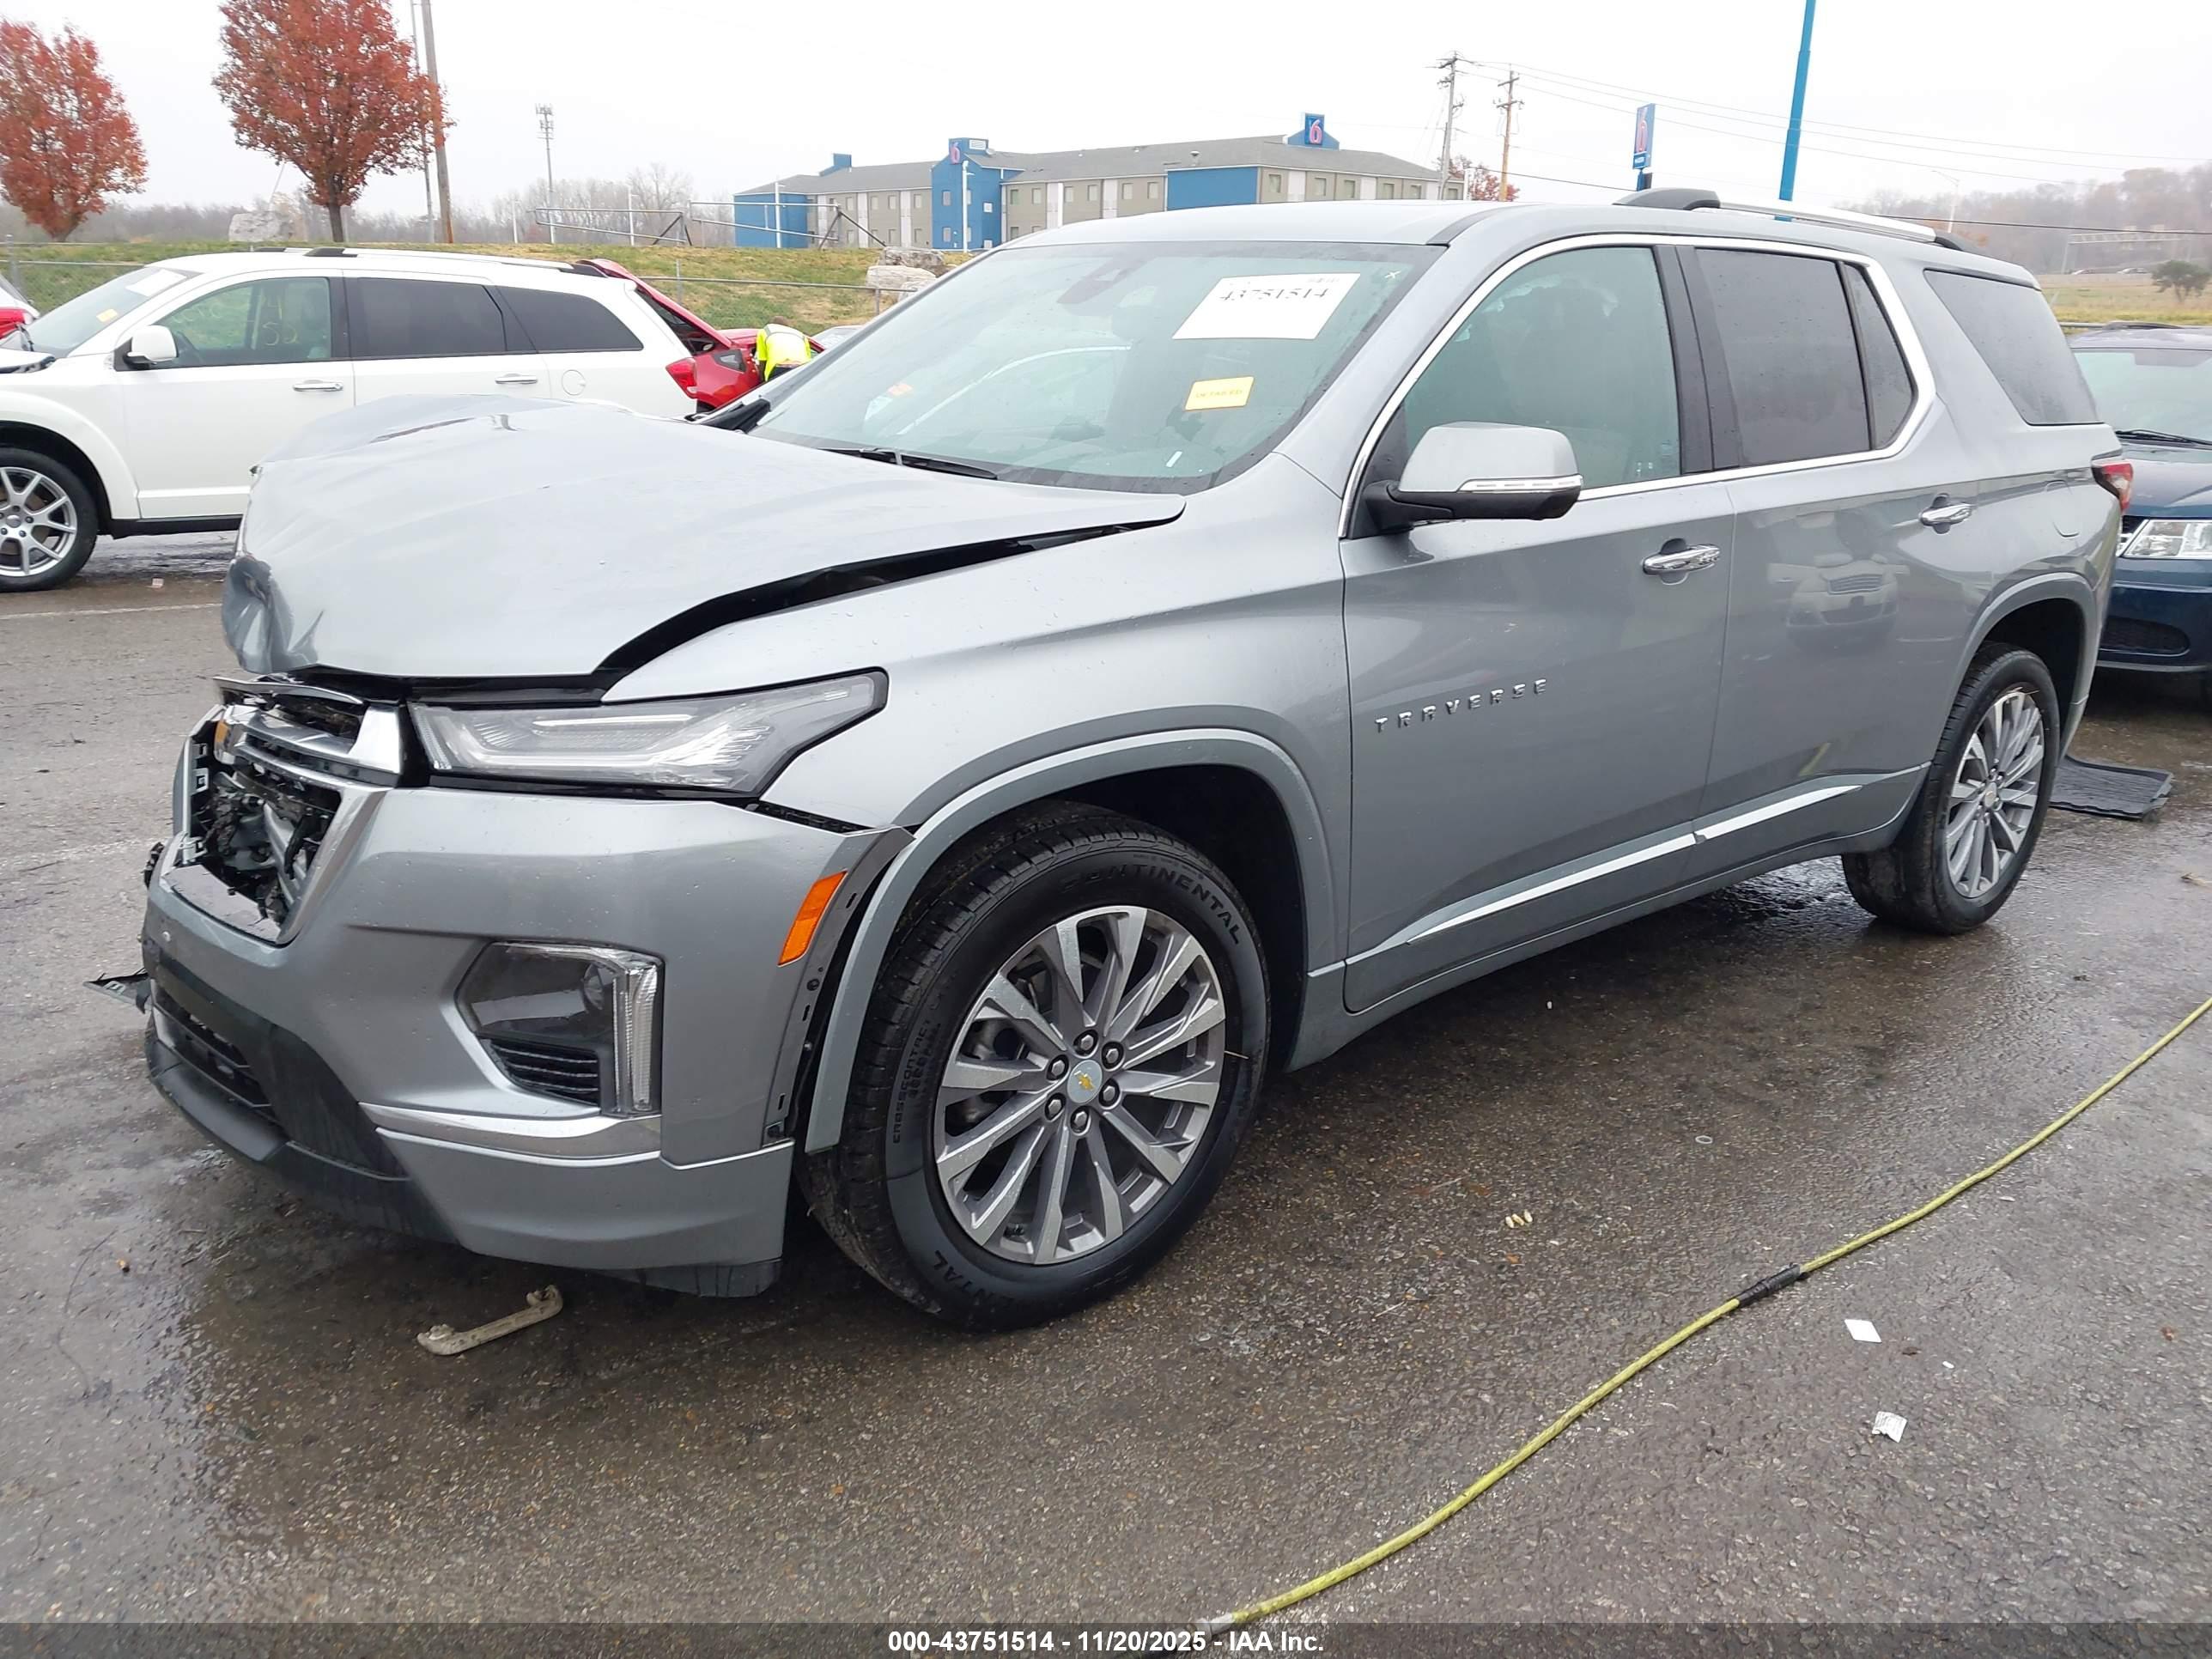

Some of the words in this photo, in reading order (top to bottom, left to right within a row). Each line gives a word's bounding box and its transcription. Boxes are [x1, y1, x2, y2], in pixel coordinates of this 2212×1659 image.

[1310, 118, 1322, 144] 6
[950, 142, 960, 164] 6
[1375, 678, 1547, 732] TRAVERSE
